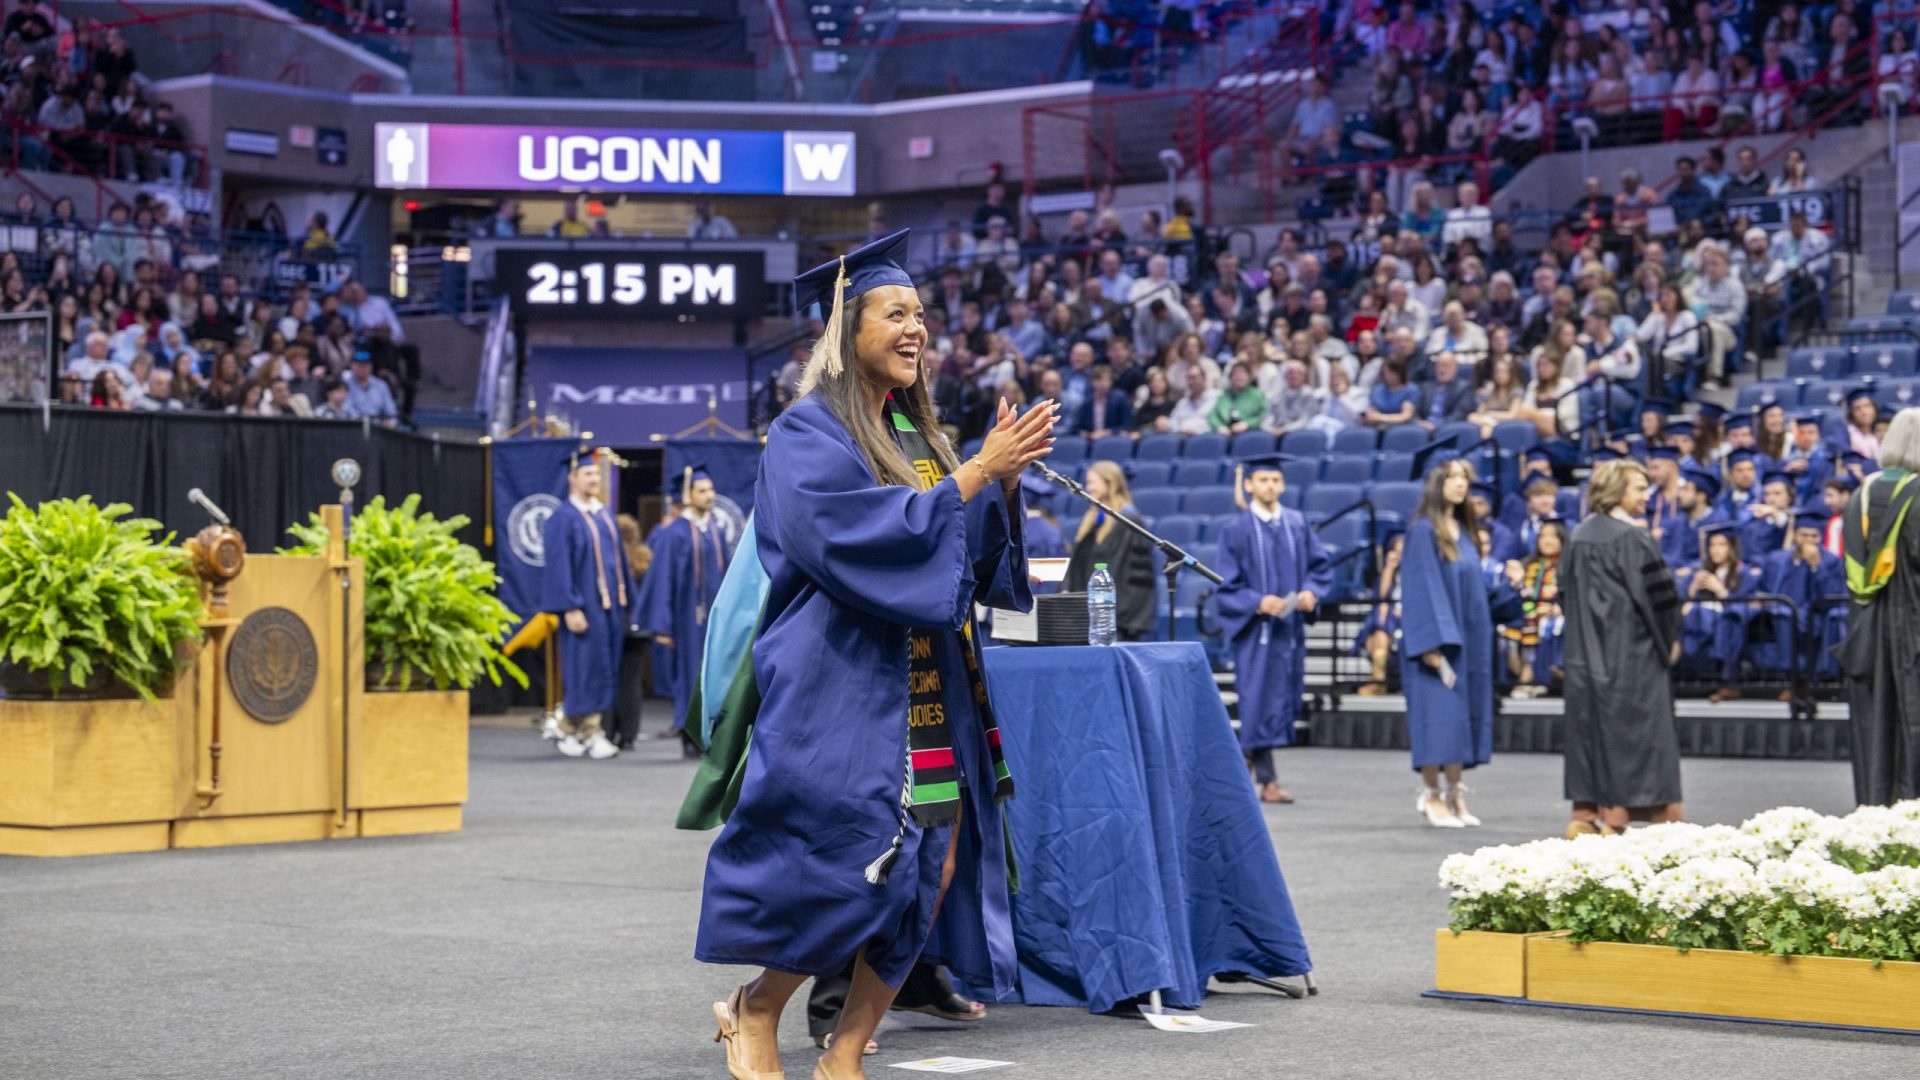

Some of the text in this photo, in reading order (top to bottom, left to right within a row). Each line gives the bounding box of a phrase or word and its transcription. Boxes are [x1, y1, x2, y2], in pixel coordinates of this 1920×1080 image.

[518, 134, 721, 185] UCONN
[793, 142, 849, 182] W
[526, 262, 736, 305] 2:15 PM
[550, 382, 716, 405] M&T
[909, 703, 945, 728] UDIES
